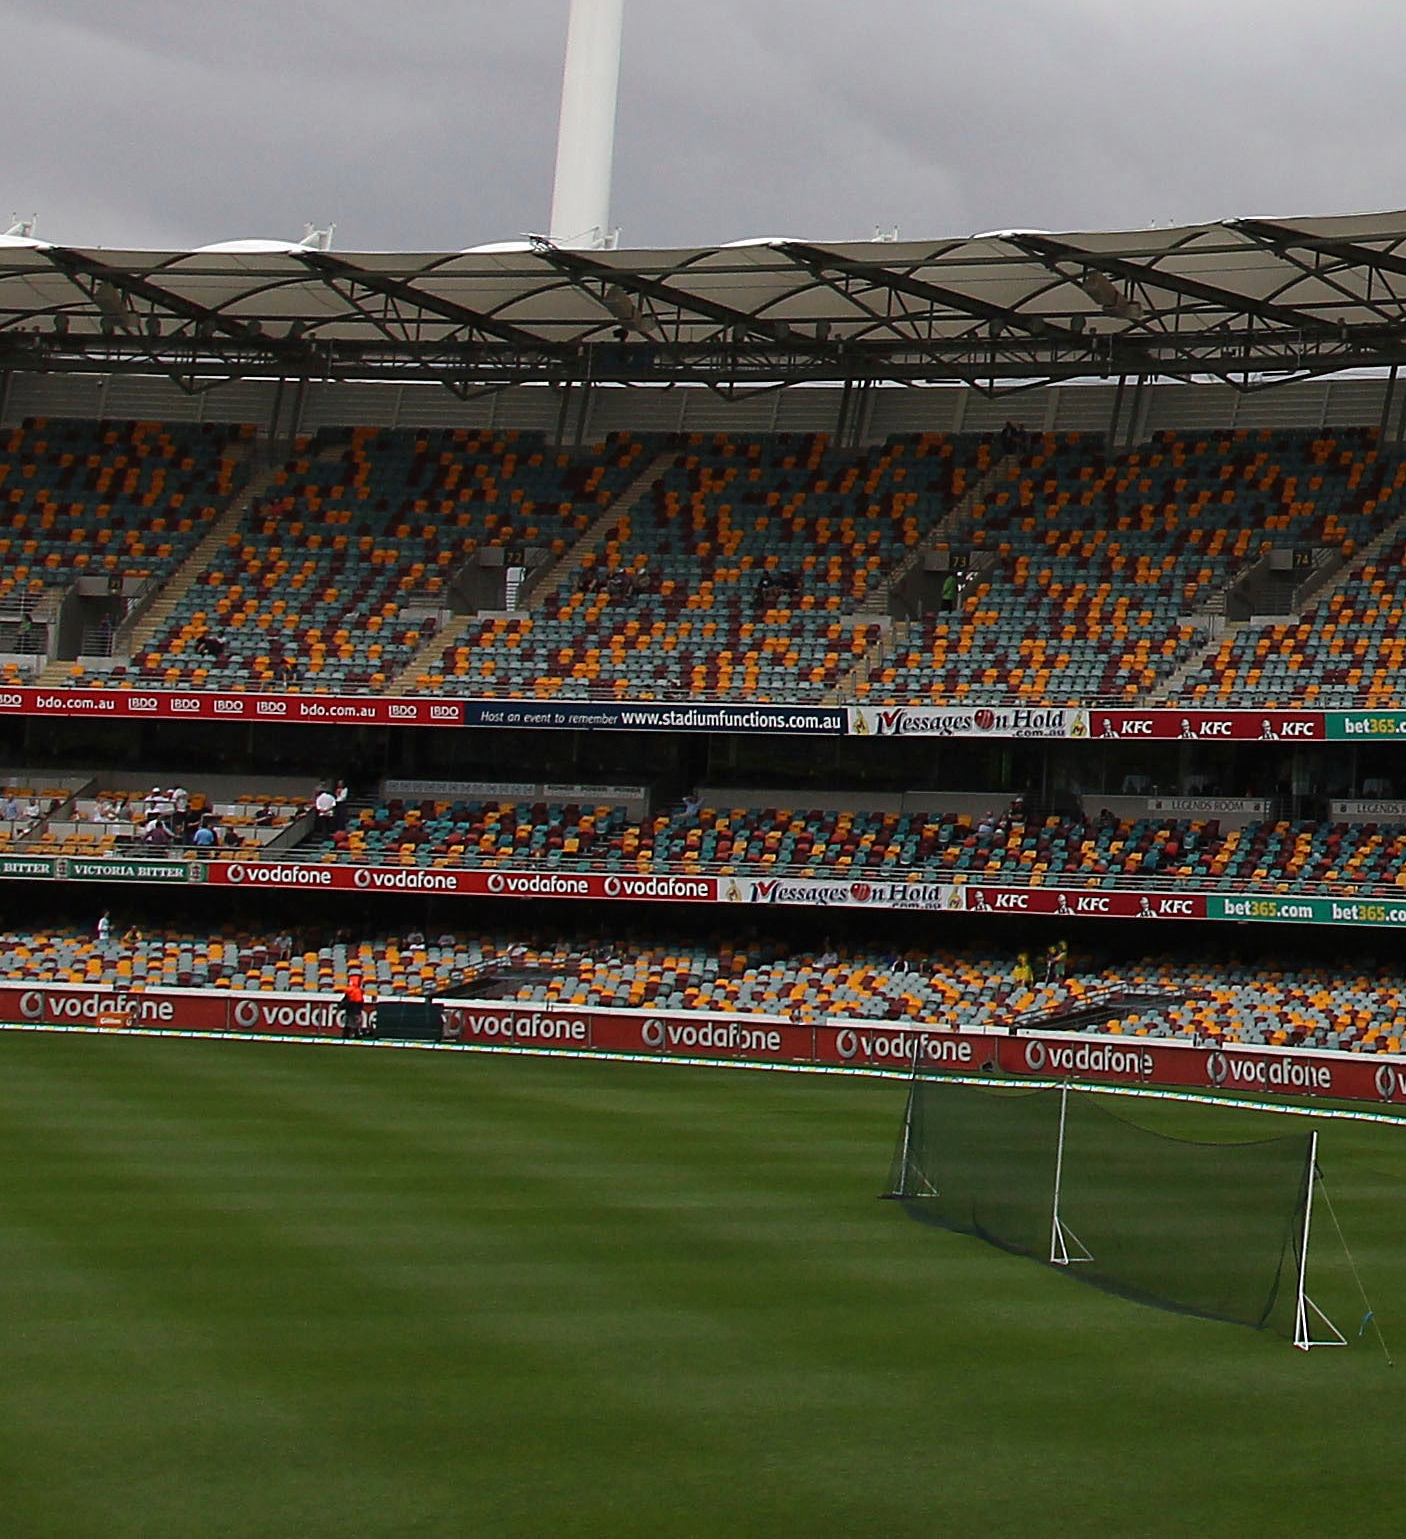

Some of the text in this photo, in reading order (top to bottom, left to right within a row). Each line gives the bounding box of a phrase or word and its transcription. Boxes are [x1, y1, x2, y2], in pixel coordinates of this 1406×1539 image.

[954, 556, 966, 567] 73
[36, 696, 114, 709] bdo.com.au
[130, 697, 158, 709] BDO
[173, 698, 200, 710] BDO
[216, 700, 243, 711] BDO
[259, 701, 287, 713] BDO
[300, 704, 376, 717] bdo.com.au
[391, 705, 417, 717] BDO
[432, 706, 459, 718] BDO
[480, 710, 841, 729] Host an event to remember www.stadiumfunctions.com.au
[876, 709, 973, 735] Messages
[1012, 709, 1064, 728] Hold
[1121, 720, 1314, 735] KFC KFC KFC
[4, 862, 49, 874] BITTER
[74, 865, 183, 877] VICTORIA BITTER
[247, 865, 331, 884] vodafone
[374, 871, 456, 889] vodafone
[507, 874, 588, 893] vodafone
[622, 877, 708, 897] vodafone
[750, 880, 848, 904] Messages
[887, 884, 940, 901] Hold
[996, 893, 1192, 915] KFC KFC KFC
[1224, 899, 1312, 919] bet365.com
[469, 1013, 586, 1039] vodafone
[666, 1021, 781, 1051] vodafone
[860, 1034, 972, 1061] vodafone
[1048, 1045, 1154, 1075] vodafone
[1229, 1057, 1332, 1089] vodafone
